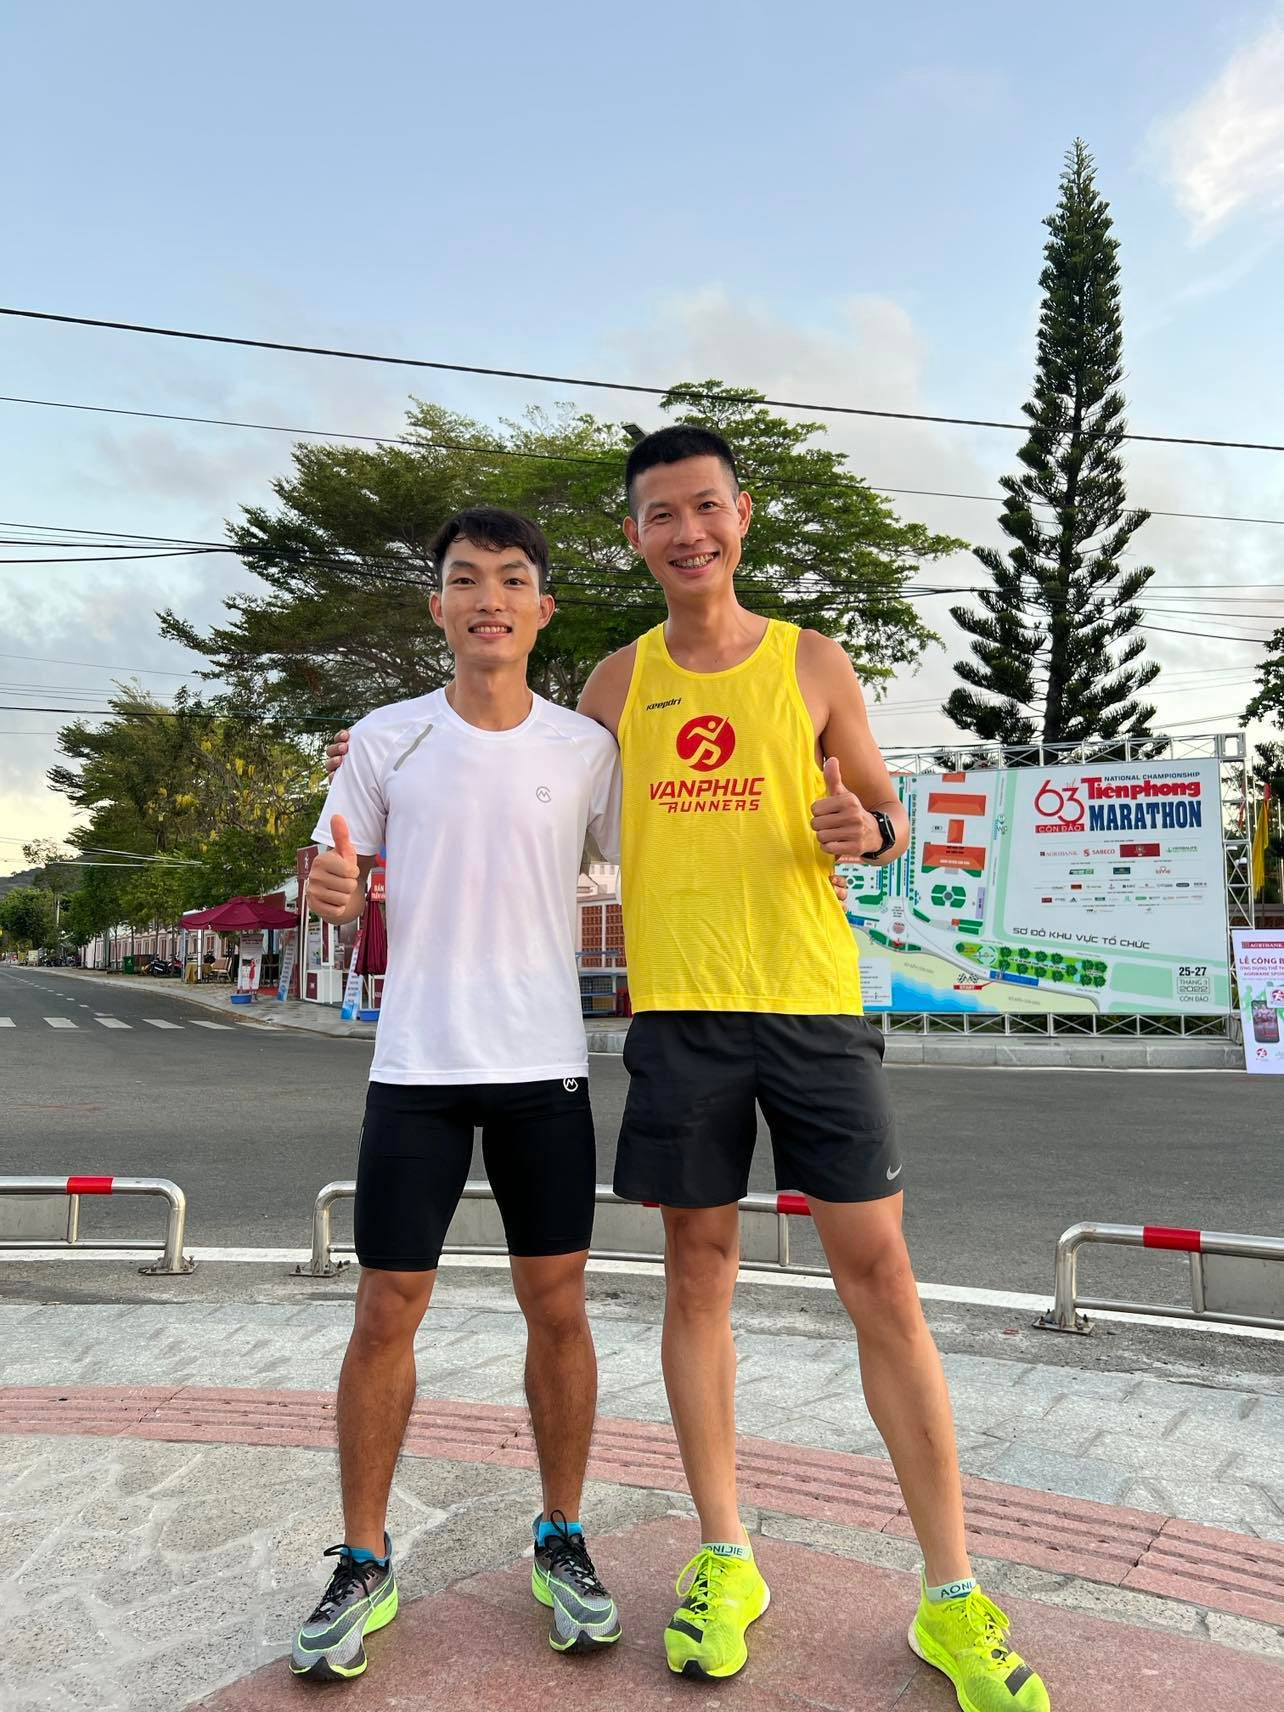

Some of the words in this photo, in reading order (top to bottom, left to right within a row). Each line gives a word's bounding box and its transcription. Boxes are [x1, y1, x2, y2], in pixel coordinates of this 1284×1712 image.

[1104, 775, 1140, 783] NATIONAL
[1142, 772, 1200, 781] CHAMPIONSHIP
[649, 778, 766, 801] VANPHUC
[659, 799, 761, 814] RUNNERS
[1034, 779, 1085, 825] 63
[1088, 800, 1202, 832] MARATHON
[1049, 931, 1072, 940] KHU
[1251, 956, 1277, 965] CÔNG
[1179, 966, 1207, 977] 25-27
[704, 1545, 744, 1556] ONIJIE
[941, 1581, 973, 1599] AONI
